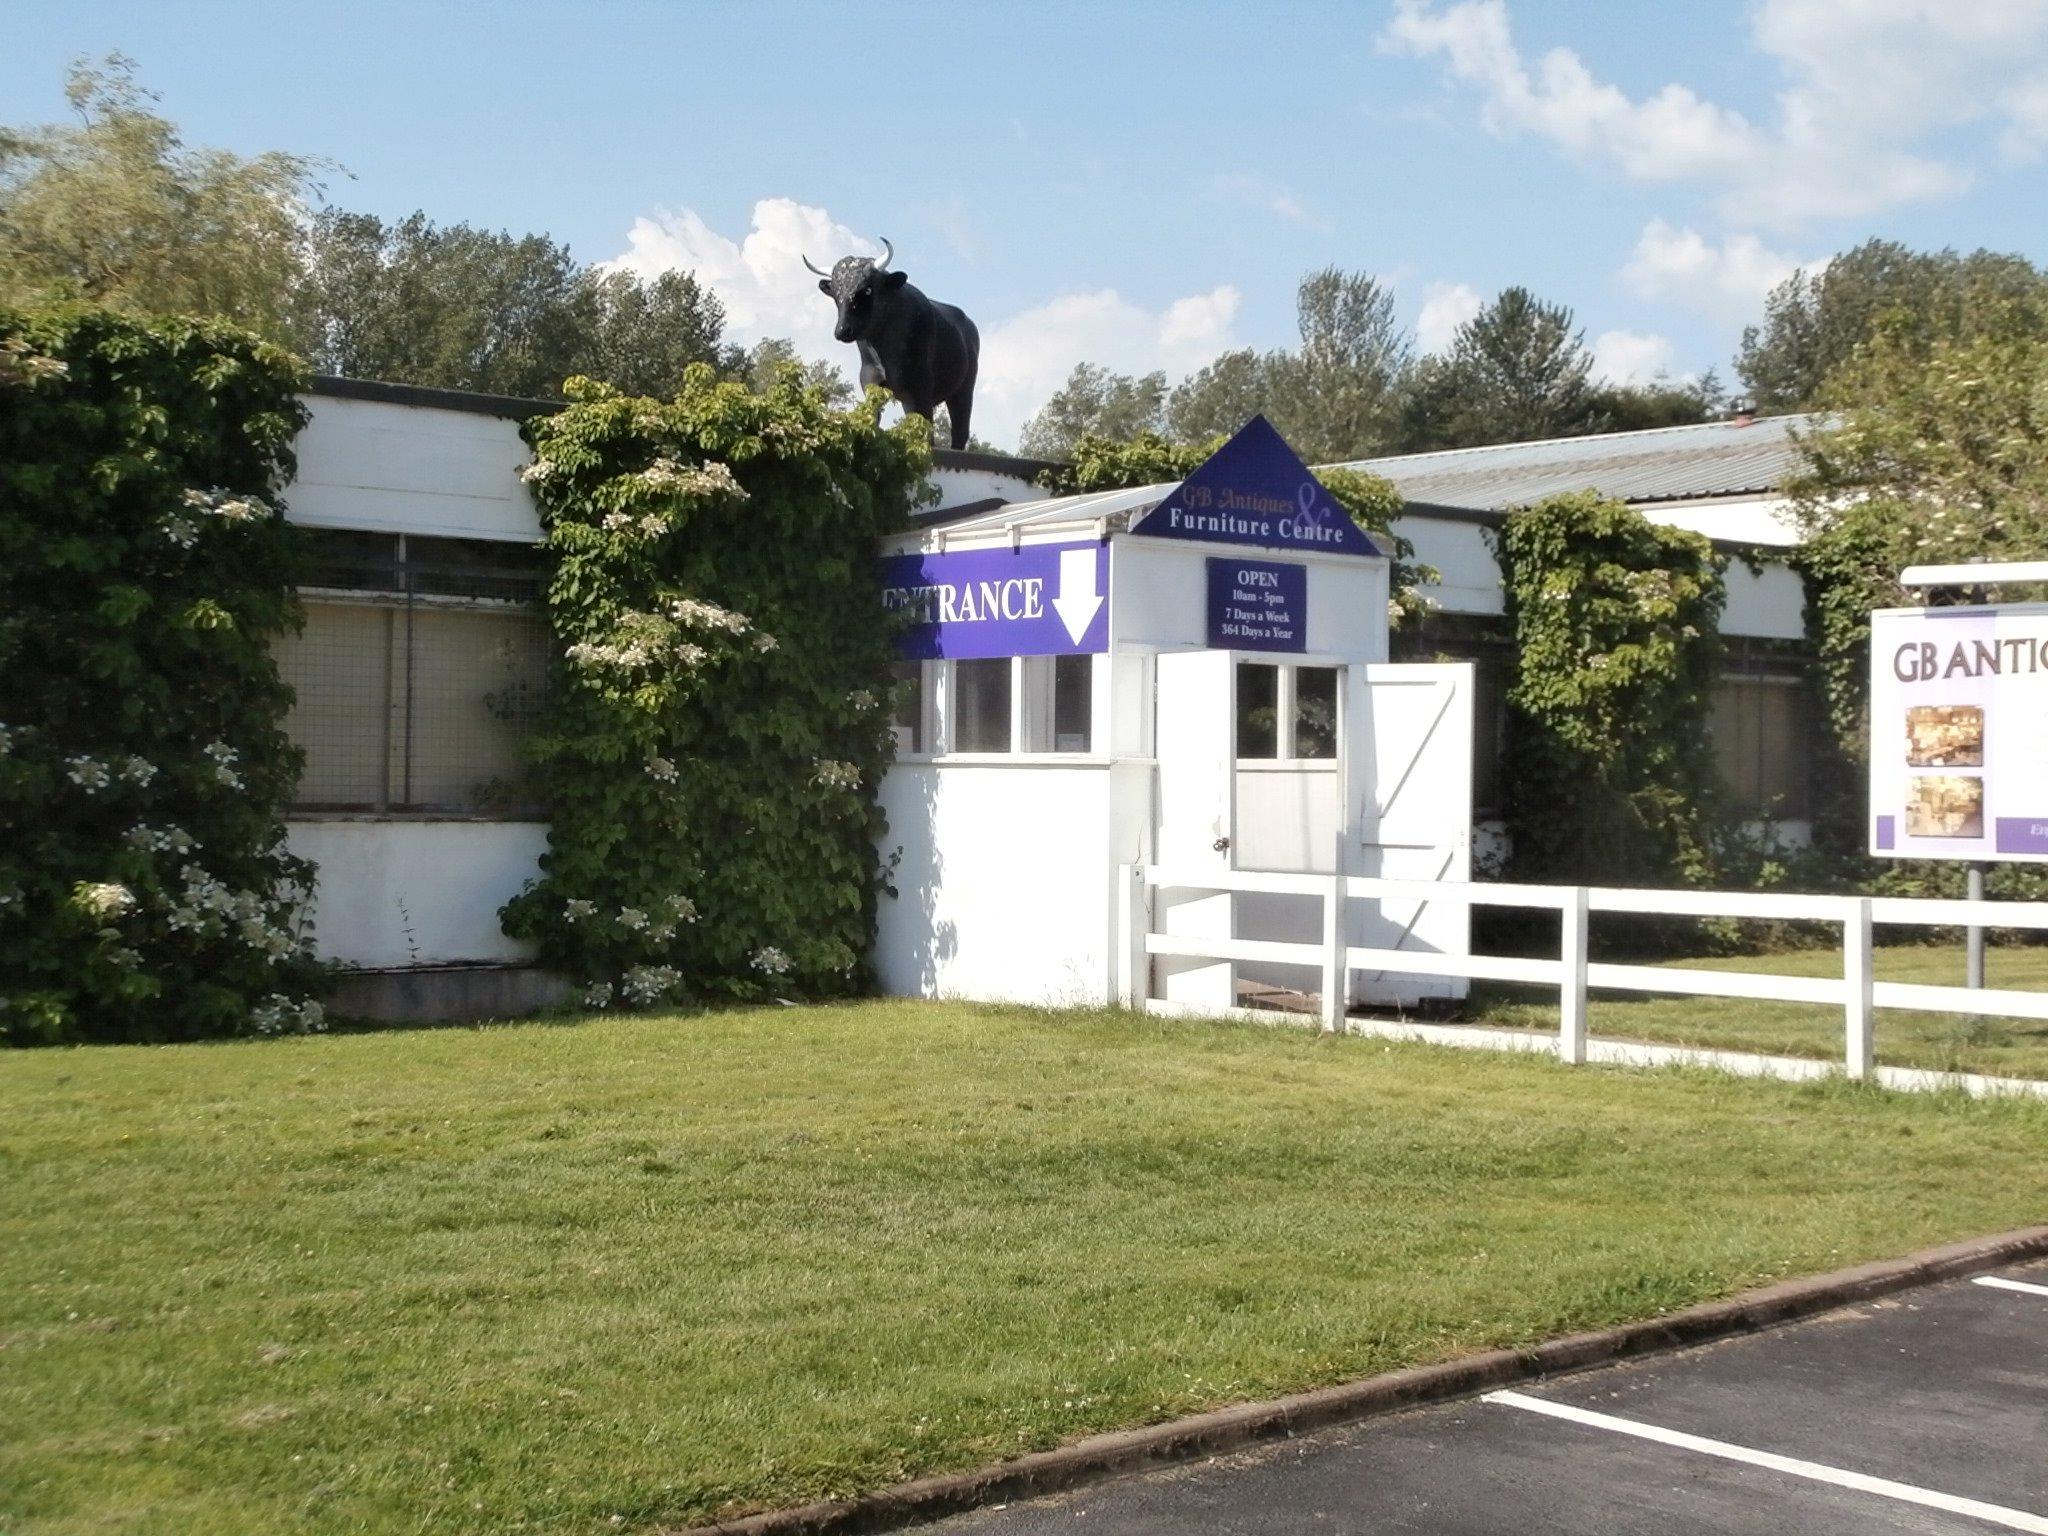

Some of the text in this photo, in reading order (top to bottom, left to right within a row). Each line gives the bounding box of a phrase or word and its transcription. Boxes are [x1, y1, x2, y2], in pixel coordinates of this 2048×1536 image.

[1182, 486, 1212, 508] GB
[1218, 487, 1295, 516] Antiques
[1169, 507, 1344, 543] Furniture Centre
[1237, 570, 1279, 587] OPEN
[1233, 589, 1257, 602] 10am
[1264, 591, 1285, 606] 5pm
[1225, 607, 1290, 623] 7 Days a Week
[1221, 623, 1239, 635] 364
[1241, 625, 1263, 640] Days
[1272, 626, 1293, 639] Year
[1893, 638, 2048, 683] GB ANTI
